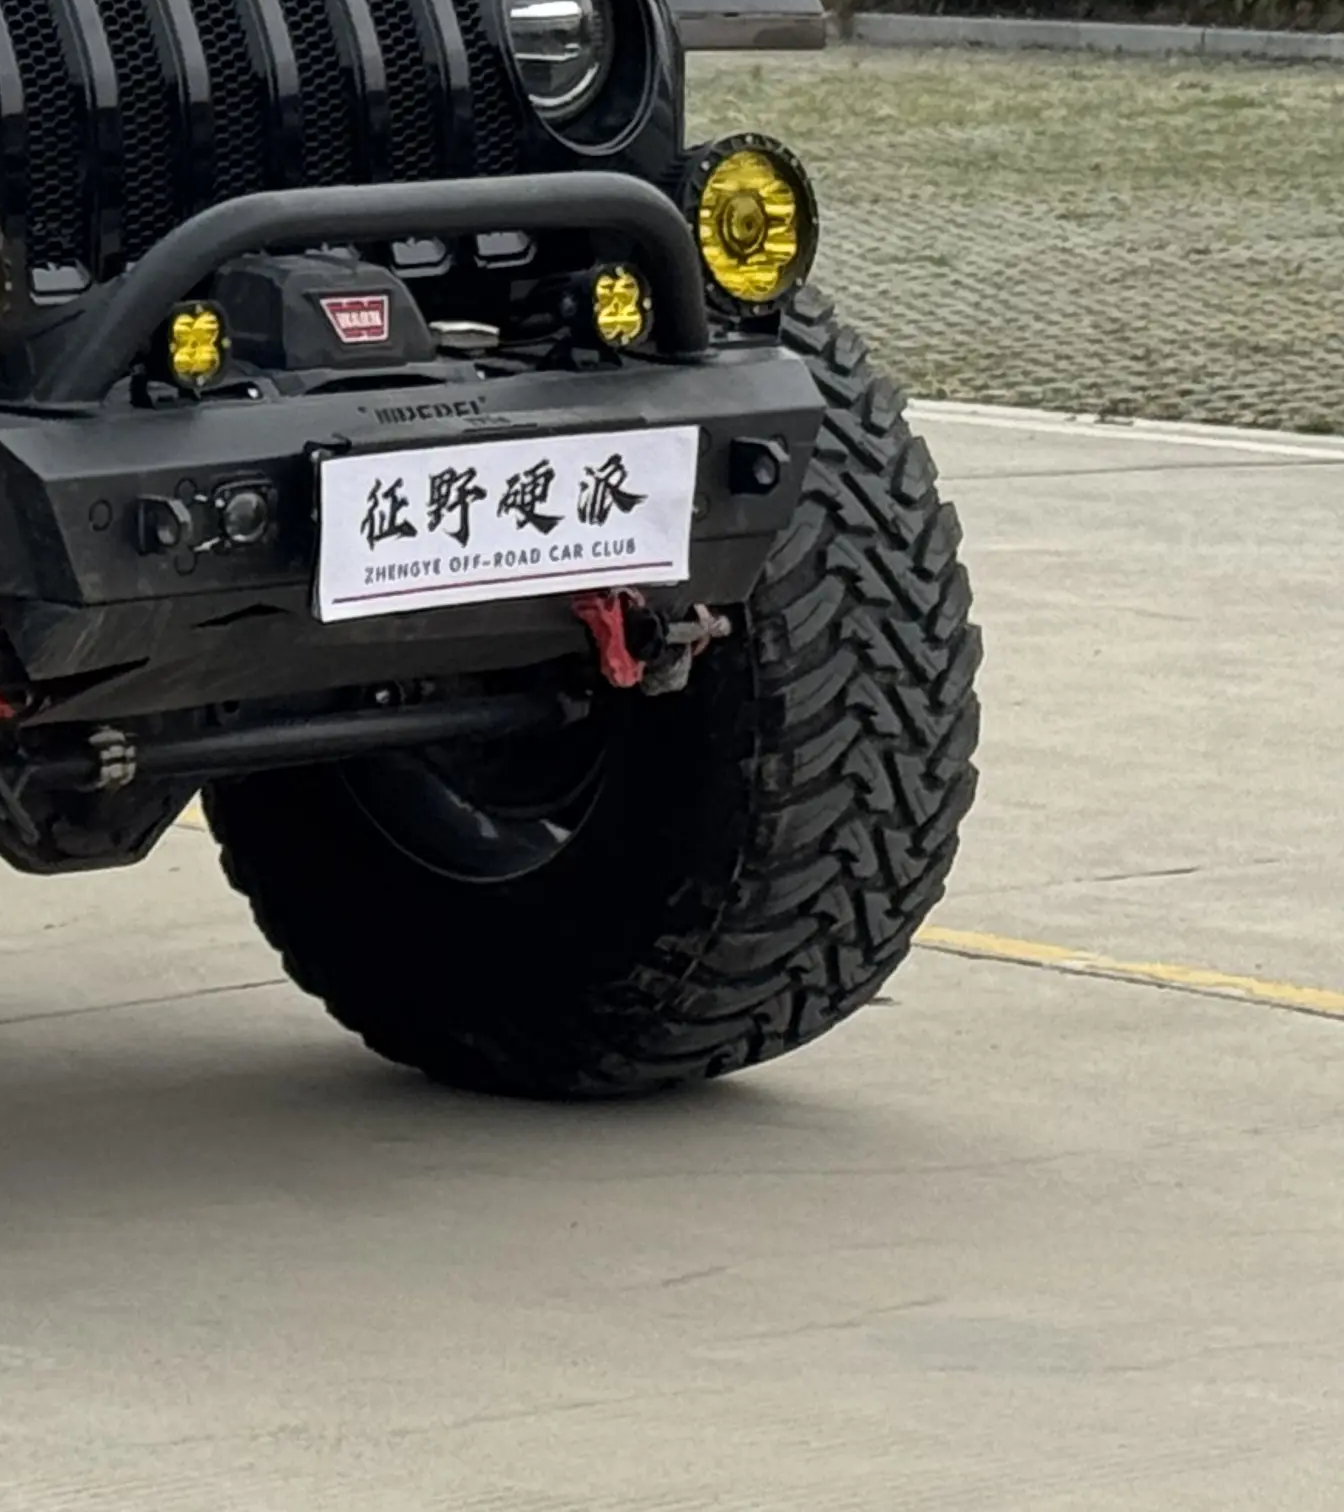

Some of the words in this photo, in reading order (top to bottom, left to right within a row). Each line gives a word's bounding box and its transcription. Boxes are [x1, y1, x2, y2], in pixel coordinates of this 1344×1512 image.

[360, 453, 648, 551] 征野硬派
[364, 558, 442, 585] ZHENGYE
[449, 547, 541, 573] OFF-ROAD
[549, 543, 584, 563] CAR
[591, 537, 637, 558] CLUB
